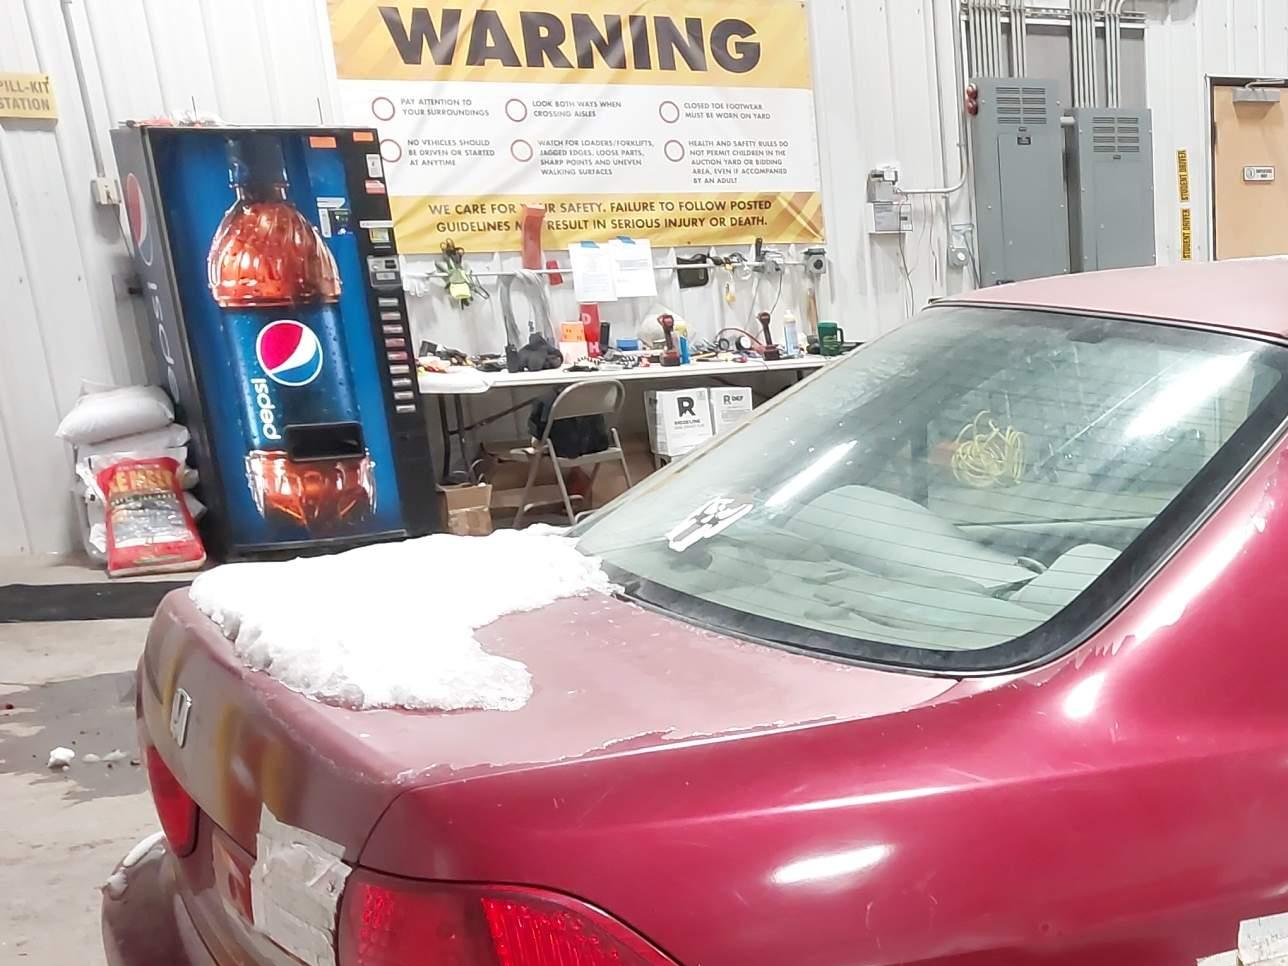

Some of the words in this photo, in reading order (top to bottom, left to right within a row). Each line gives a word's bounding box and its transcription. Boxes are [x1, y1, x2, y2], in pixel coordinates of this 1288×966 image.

[379, 6, 761, 74] WARNING
[401, 98, 415, 106] PAY
[418, 98, 460, 106] ATTENTION
[462, 98, 472, 106] TO
[532, 100, 553, 108] LOOK
[555, 100, 575, 108] BOTH
[577, 100, 598, 108] WAYS
[599, 100, 622, 108] WHEN
[428, 204, 450, 214] WE
[455, 204, 486, 214] CARE
[491, 204, 516, 214] FOR
[560, 202, 606, 214] SAFETY.
[610, 202, 656, 212] FAILURE
[658, 201, 675, 212] TO
[678, 201, 727, 211] FOLLOW
[730, 200, 772, 210] POSTED
[436, 221, 510, 232] GUIDELINES
[548, 220, 588, 231] RESULT
[593, 219, 606, 230] IN
[611, 218, 660, 229] SERIOUS
[664, 217, 705, 228] INJURY
[709, 217, 727, 227] OR
[730, 216, 768, 226] DEATH.
[251, 378, 282, 440] pepsi
[676, 396, 696, 417] R
